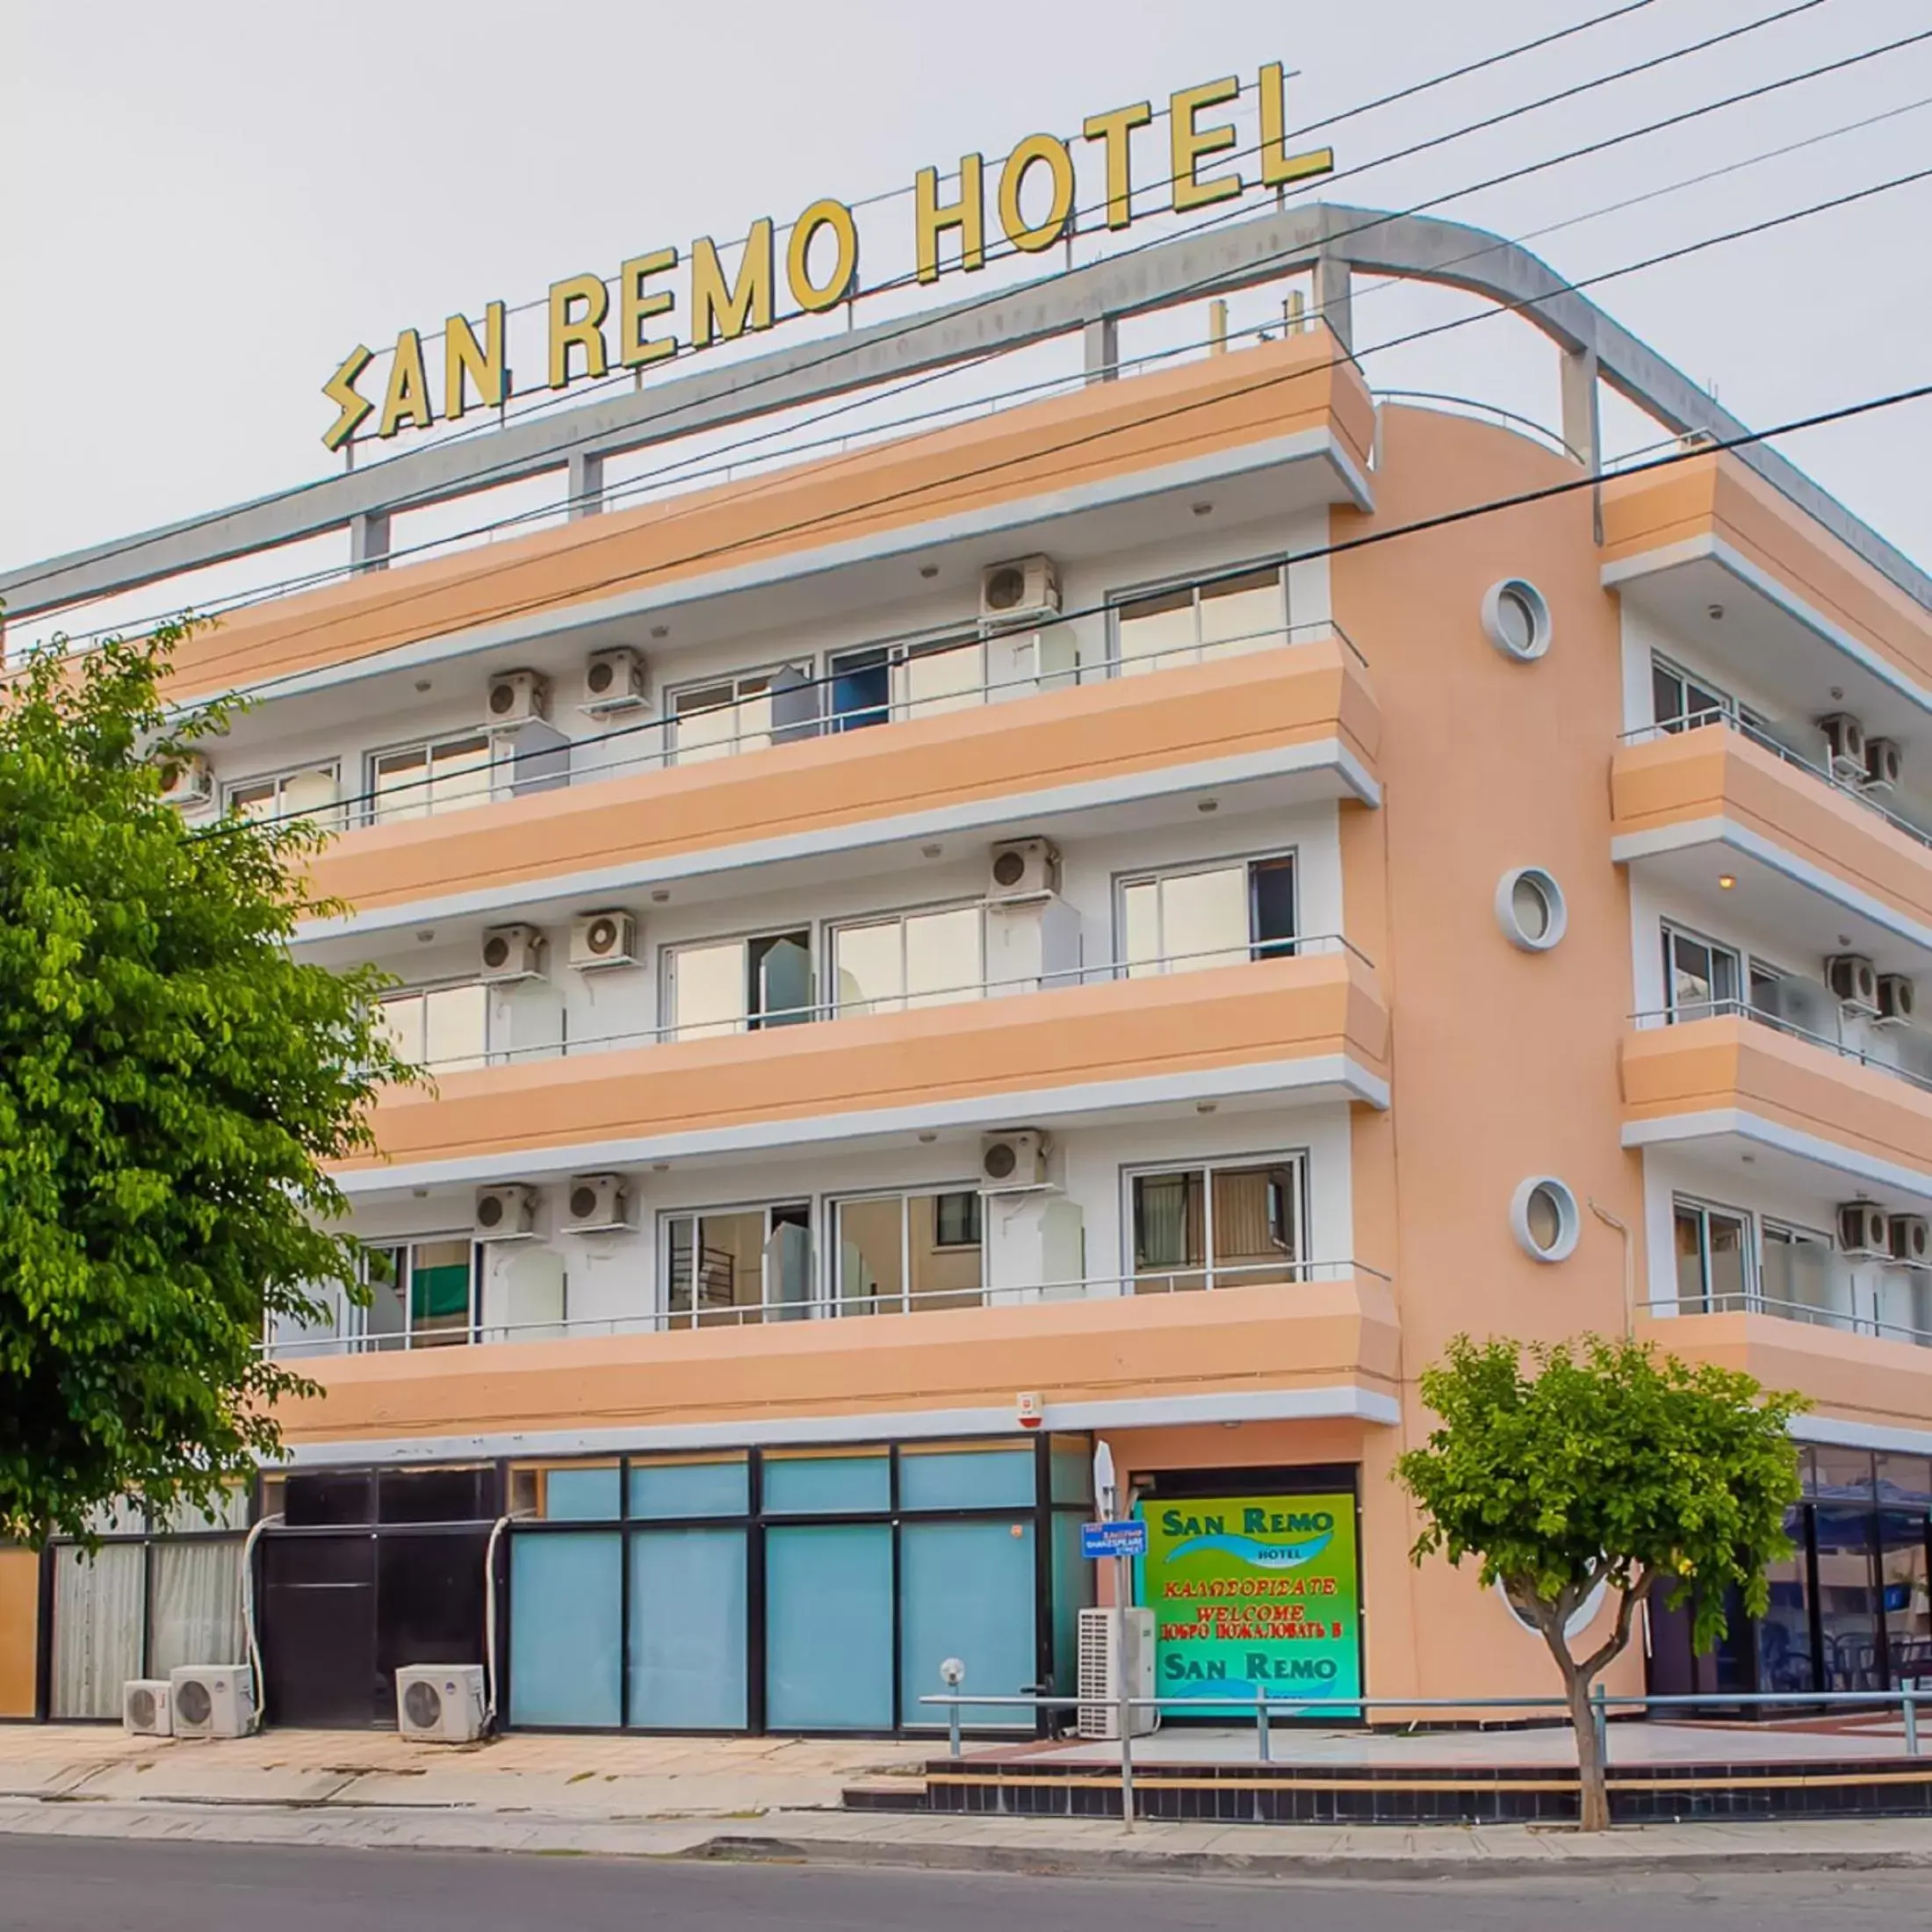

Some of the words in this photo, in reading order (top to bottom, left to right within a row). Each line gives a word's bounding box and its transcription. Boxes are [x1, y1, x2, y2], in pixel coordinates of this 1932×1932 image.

[548, 198, 859, 390] REMO
[914, 61, 1333, 285] HOTEL
[1258, 1549, 1302, 1560] HOTEL
[1196, 1604, 1306, 1623] WELCOME
[1159, 1622, 1210, 1642] ДОБРО
